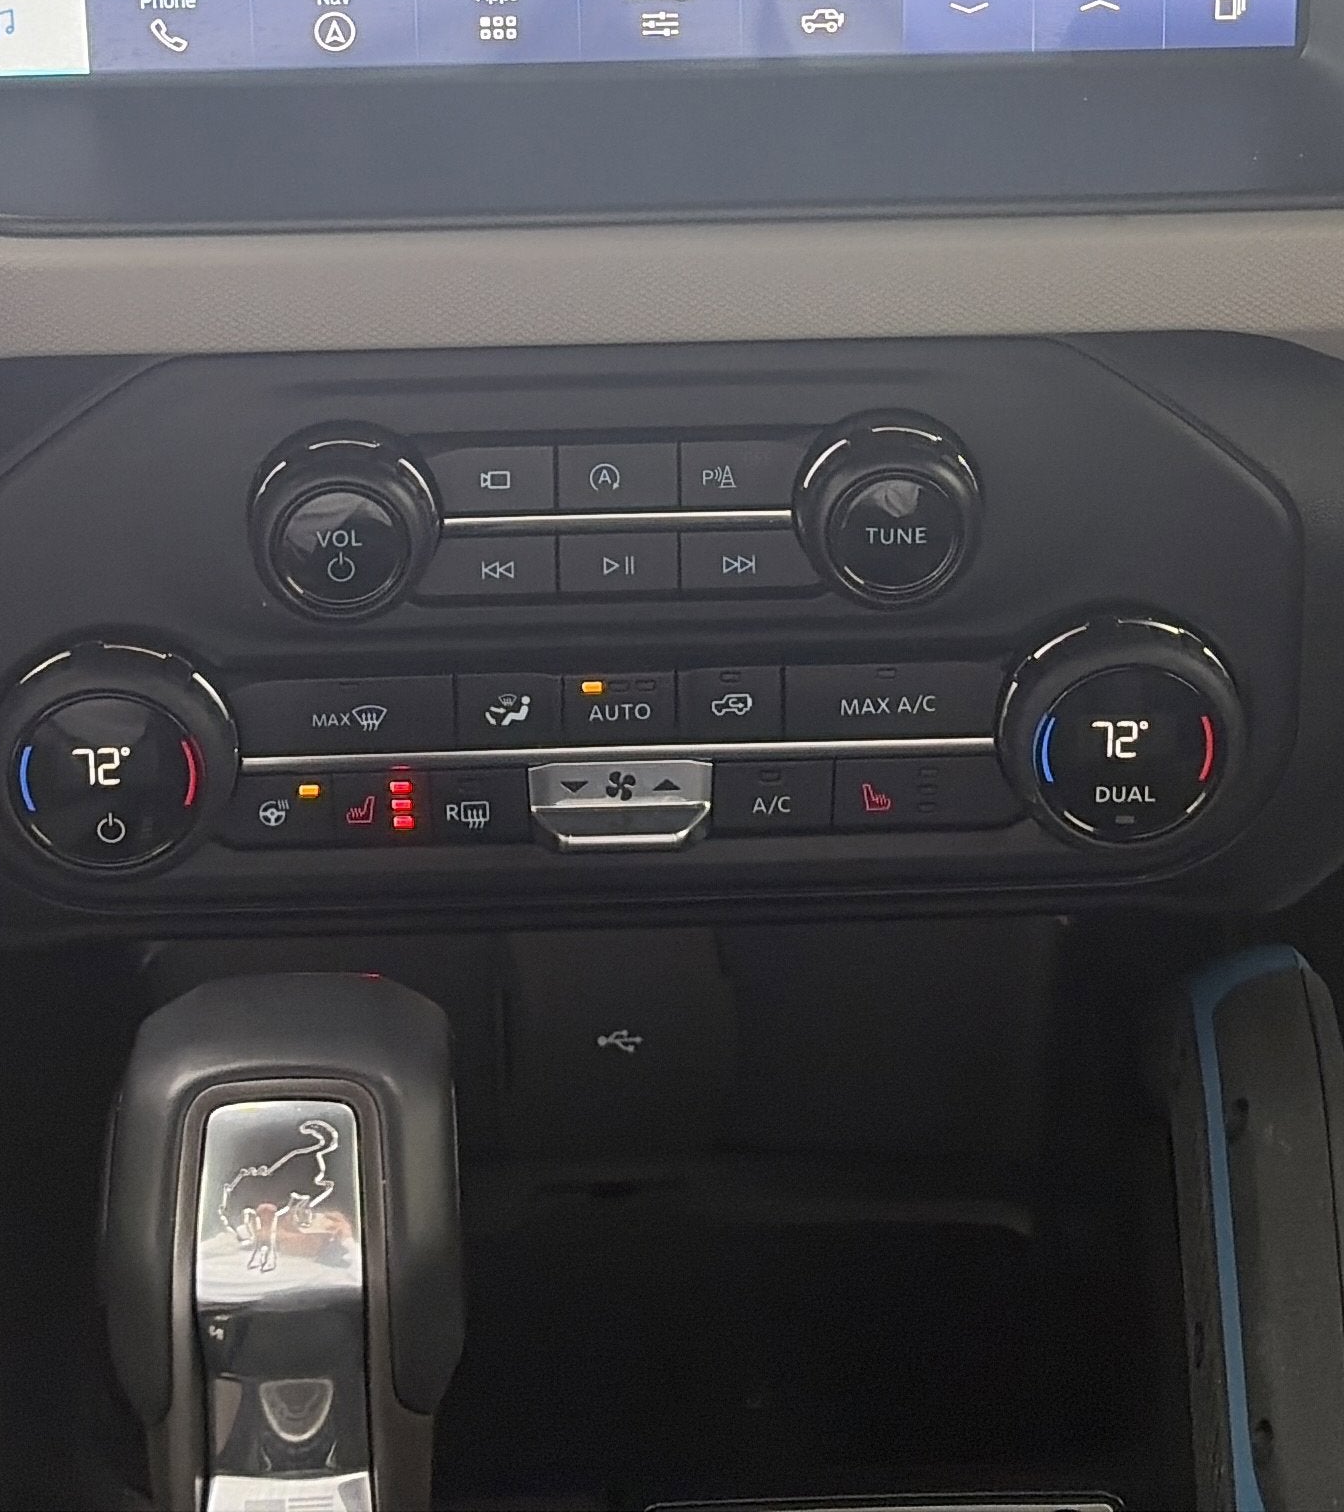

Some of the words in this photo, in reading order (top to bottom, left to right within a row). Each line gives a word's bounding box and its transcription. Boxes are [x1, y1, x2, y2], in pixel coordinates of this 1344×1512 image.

[316, 529, 363, 548] VOL
[866, 527, 927, 545] TUNE
[588, 702, 652, 721] AUTO
[840, 698, 890, 716] MAX
[897, 694, 937, 714] A/C
[311, 711, 351, 729] MAX
[1094, 785, 1156, 804] DUAL
[752, 794, 791, 815] A/C
